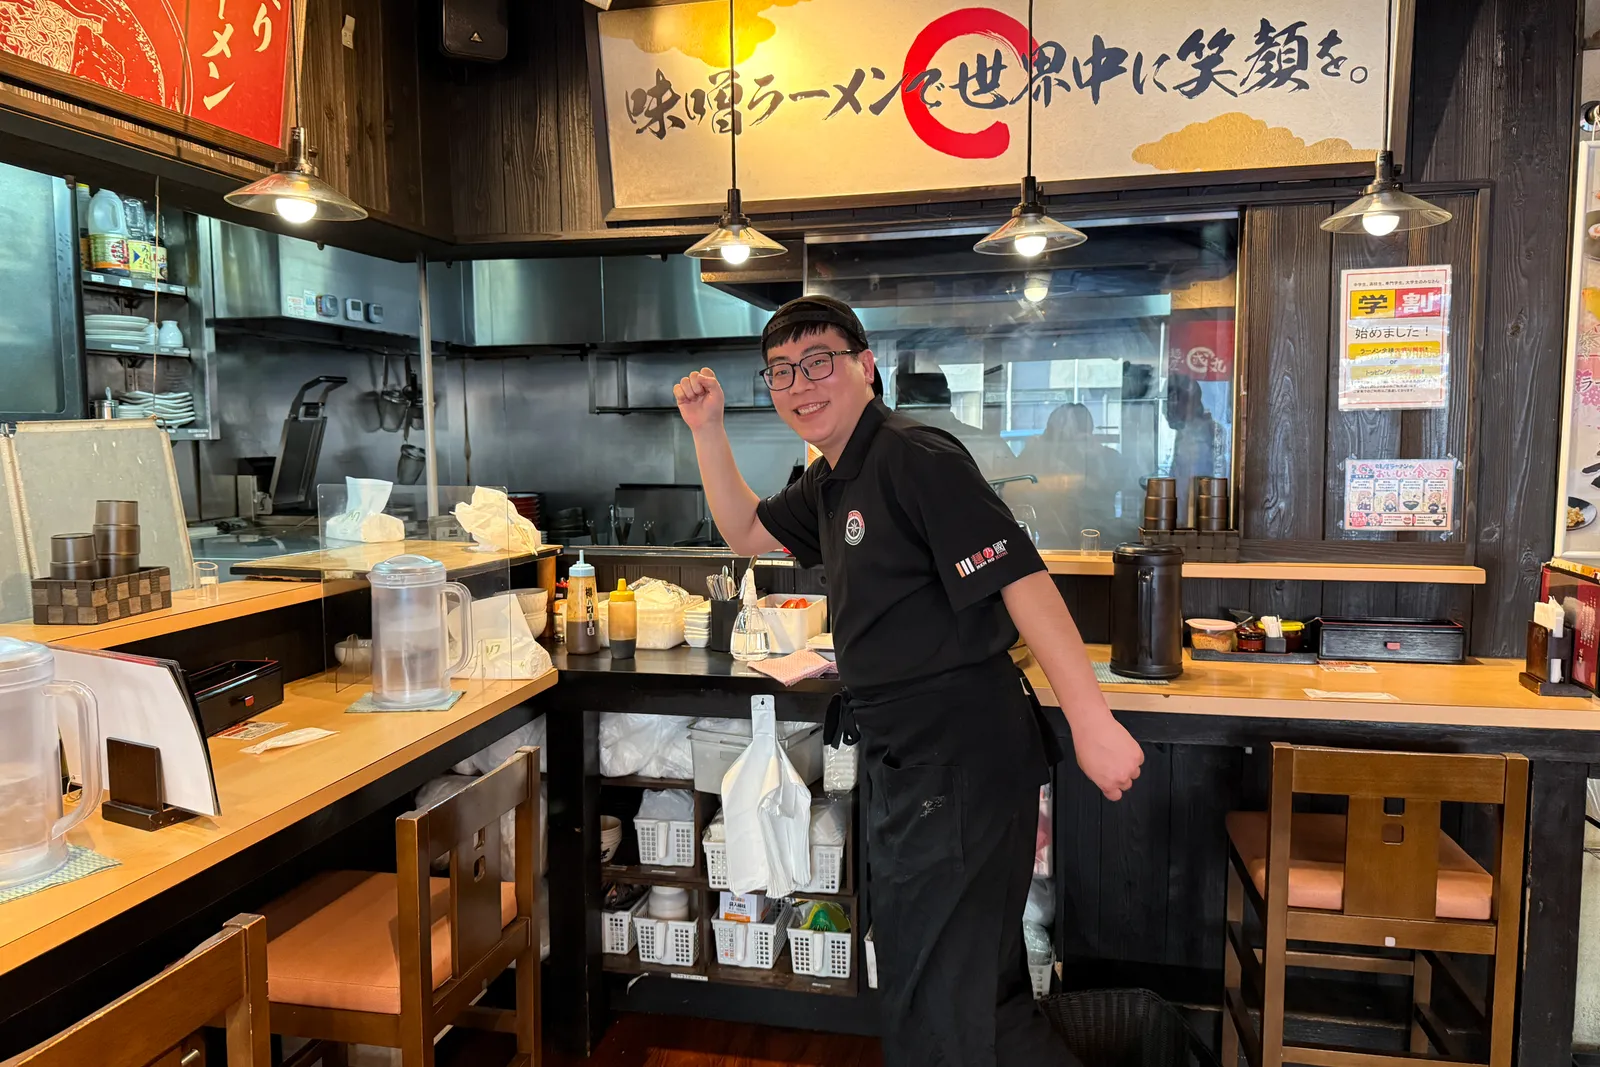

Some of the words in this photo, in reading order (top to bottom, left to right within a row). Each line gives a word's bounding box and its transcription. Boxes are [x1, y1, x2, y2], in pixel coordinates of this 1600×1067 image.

[253, 0, 280, 52] り
[625, 16, 1369, 139] 味噌ラーメンで世界中に笑顔を。
[1357, 291, 1435, 315] 学割
